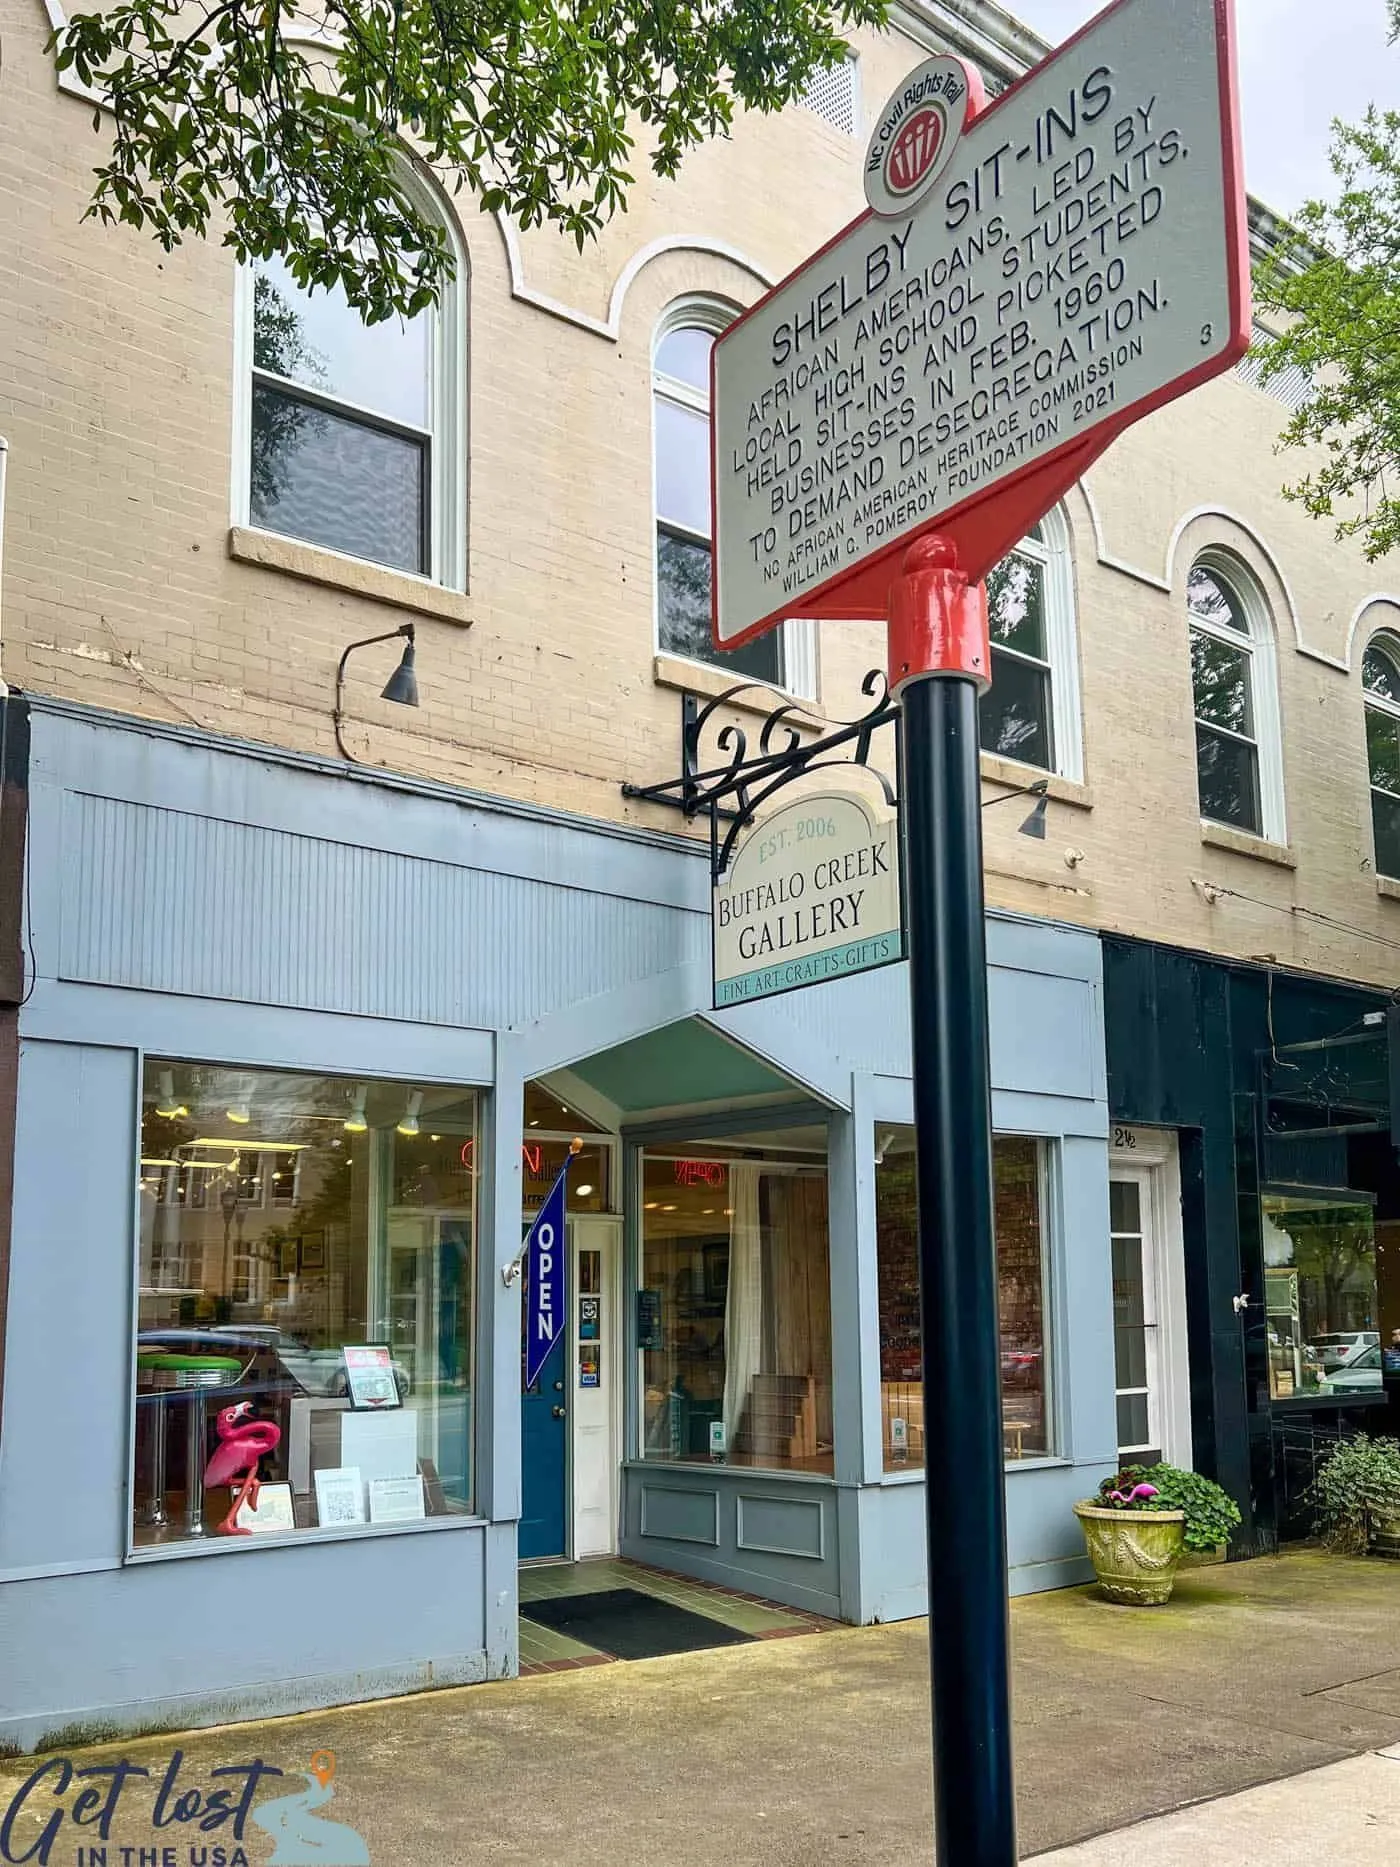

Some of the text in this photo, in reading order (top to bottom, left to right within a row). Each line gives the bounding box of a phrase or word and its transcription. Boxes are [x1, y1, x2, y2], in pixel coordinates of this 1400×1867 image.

[771, 66, 1112, 367] SHELBY SIT-INS
[867, 71, 966, 173] NC Civil Rights Trail
[747, 338, 839, 432] AFRICAN
[1032, 146, 1096, 216] LED
[1113, 95, 1156, 156] BY
[747, 186, 1162, 498] HELD SIT-INS AND PICKETED
[1200, 323, 1212, 346] 3
[733, 410, 801, 473] LOCAL
[815, 355, 865, 416] HIGH
[879, 277, 985, 367] SCHOOL
[749, 279, 1168, 562] TO DEMAND DESEGREGATION.
[763, 335, 1144, 584] NC AFRICAN AMERICAN HERITAGE COMMISSION
[771, 258, 1125, 515] BUSINESSES IN FEB. 1960
[783, 380, 1116, 593] WILLIAM G. POMEROY FOUNDATION 2021
[719, 840, 889, 927] BUFFALO CREEK
[738, 889, 865, 960] GALLERY
[759, 817, 836, 864] EST. 2006
[723, 980, 751, 1001] FINE
[537, 1222, 555, 1341] OPEN
